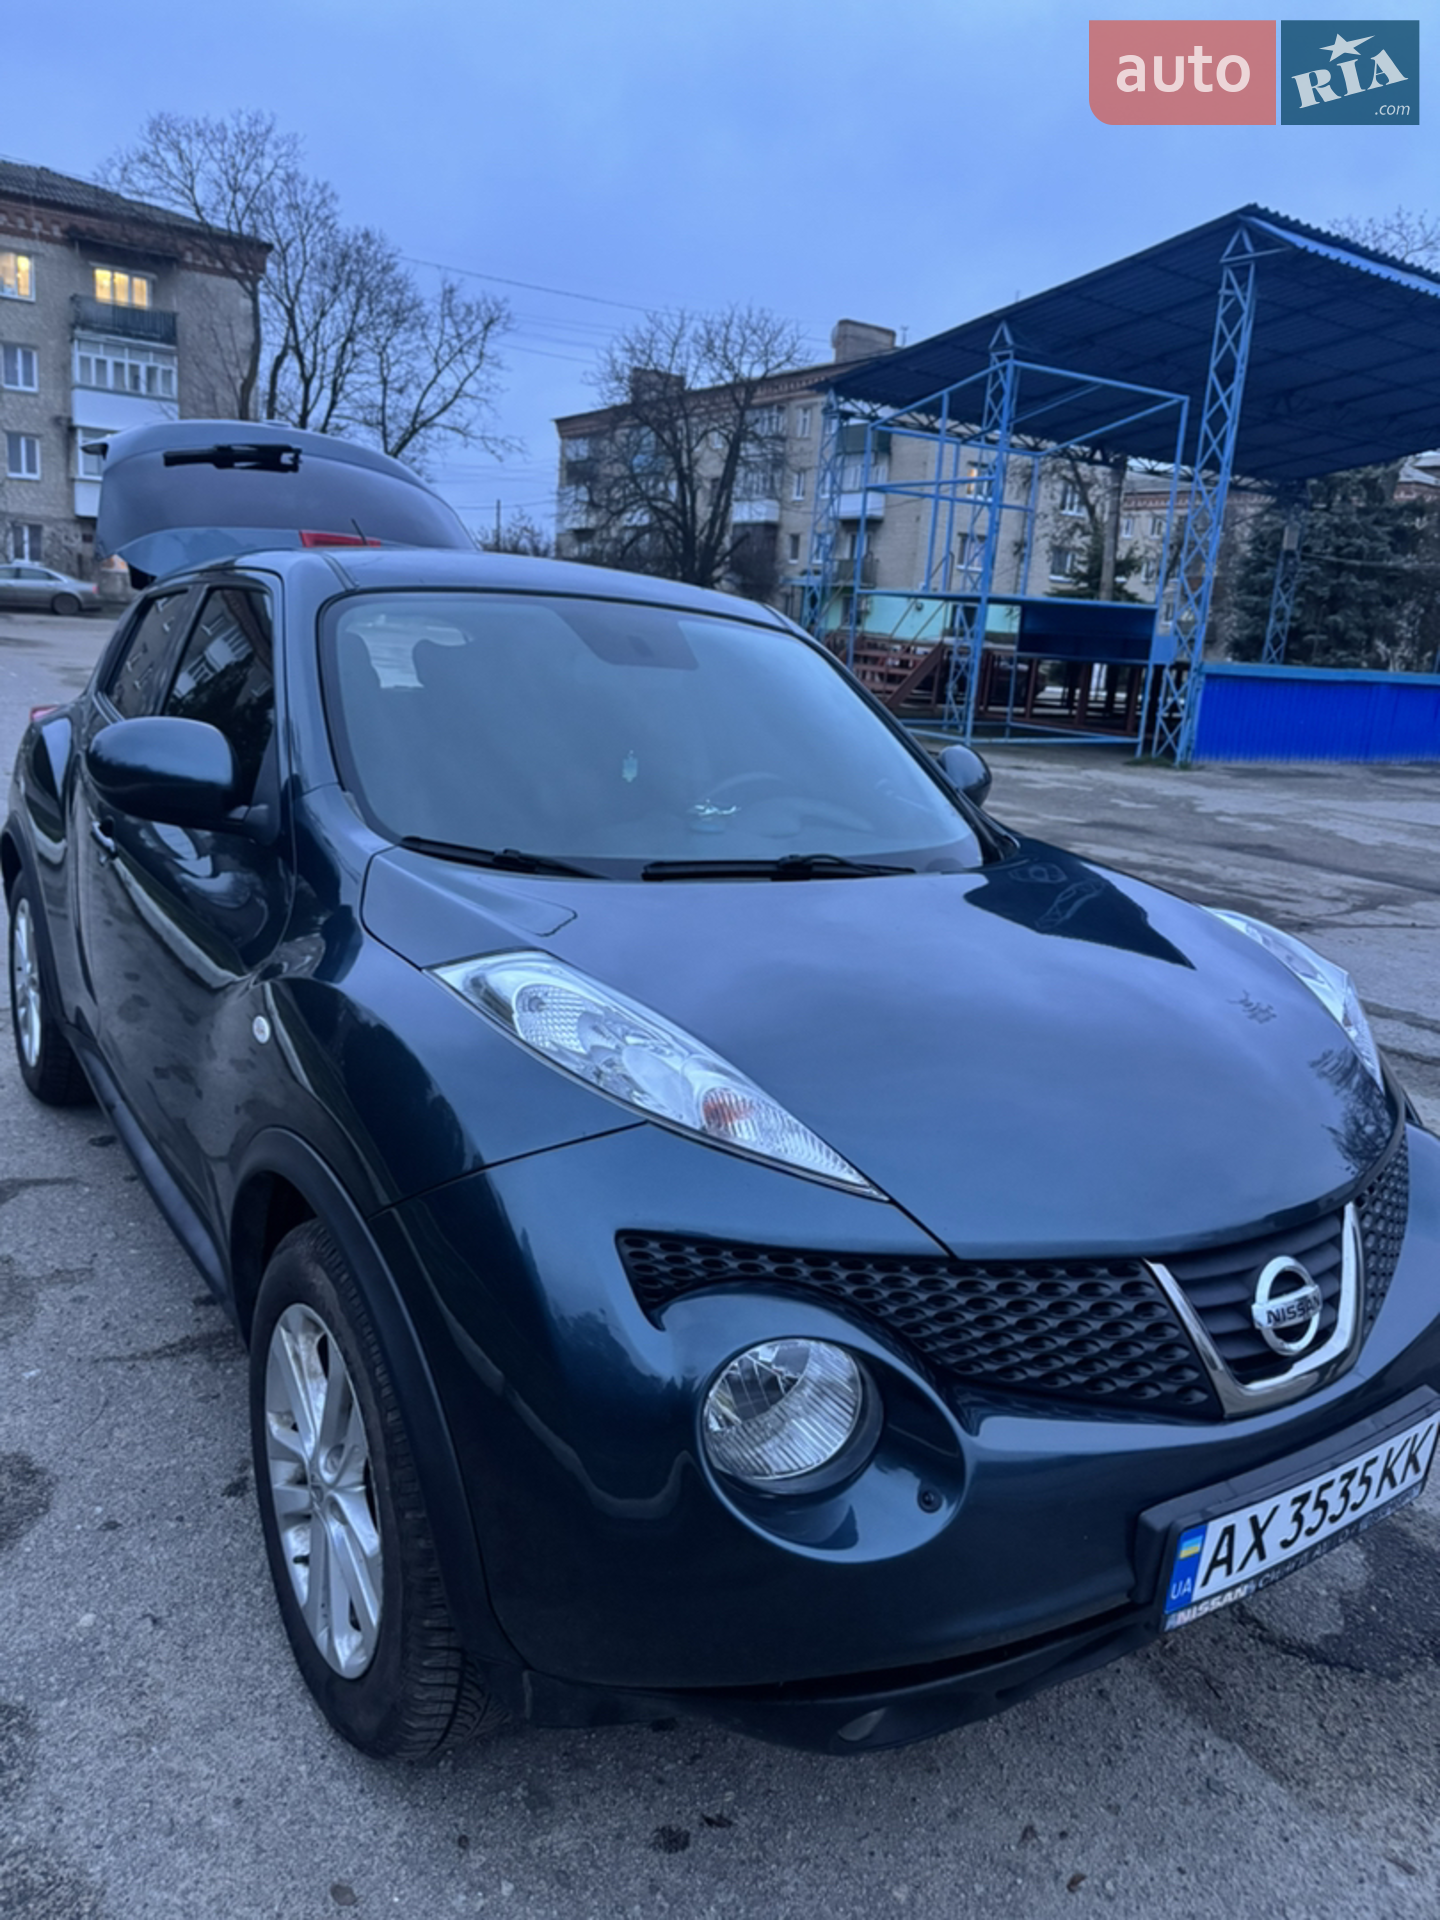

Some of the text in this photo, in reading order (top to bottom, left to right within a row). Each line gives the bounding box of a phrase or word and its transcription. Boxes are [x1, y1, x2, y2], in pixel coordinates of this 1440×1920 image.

[1266, 1295, 1319, 1325] NISSAN
[1170, 1577, 1192, 1599] UA
[1175, 1583, 1249, 1626] NISSAN
